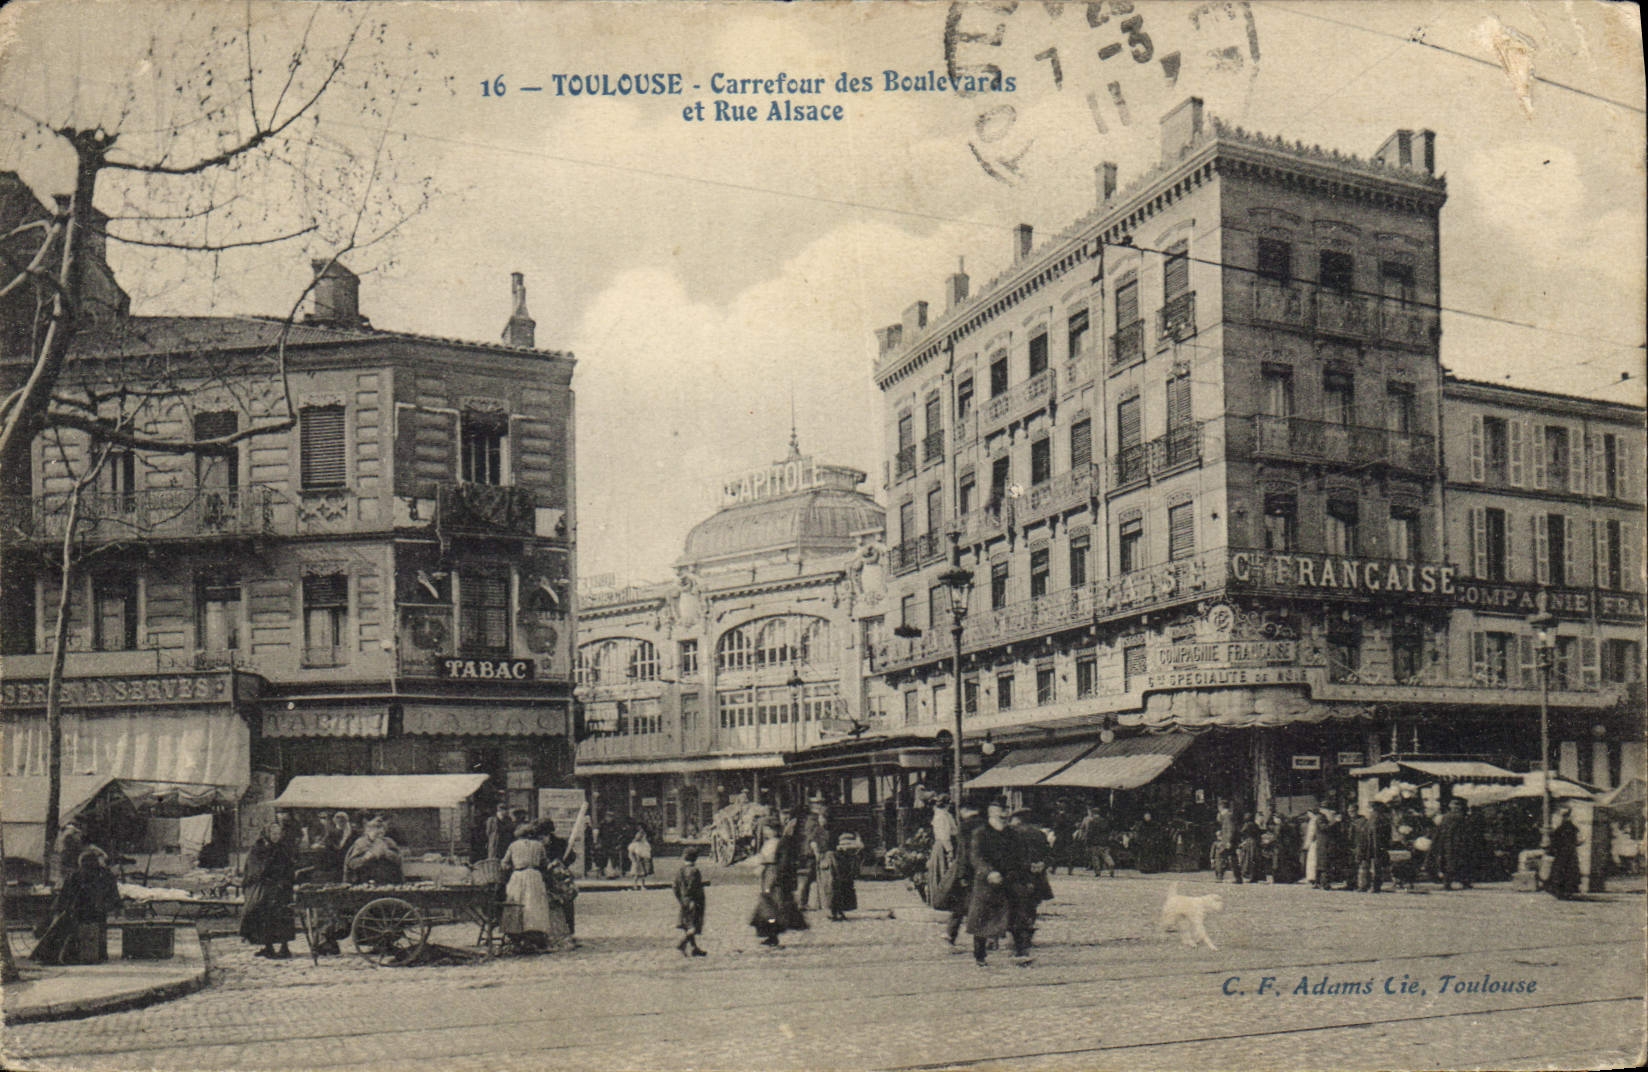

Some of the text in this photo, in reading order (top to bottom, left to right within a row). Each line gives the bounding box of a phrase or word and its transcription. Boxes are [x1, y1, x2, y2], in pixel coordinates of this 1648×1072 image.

[724, 457, 826, 503] CAPITOLE
[1456, 585, 1589, 612] COMPANIE
[444, 659, 528, 681] TABAC
